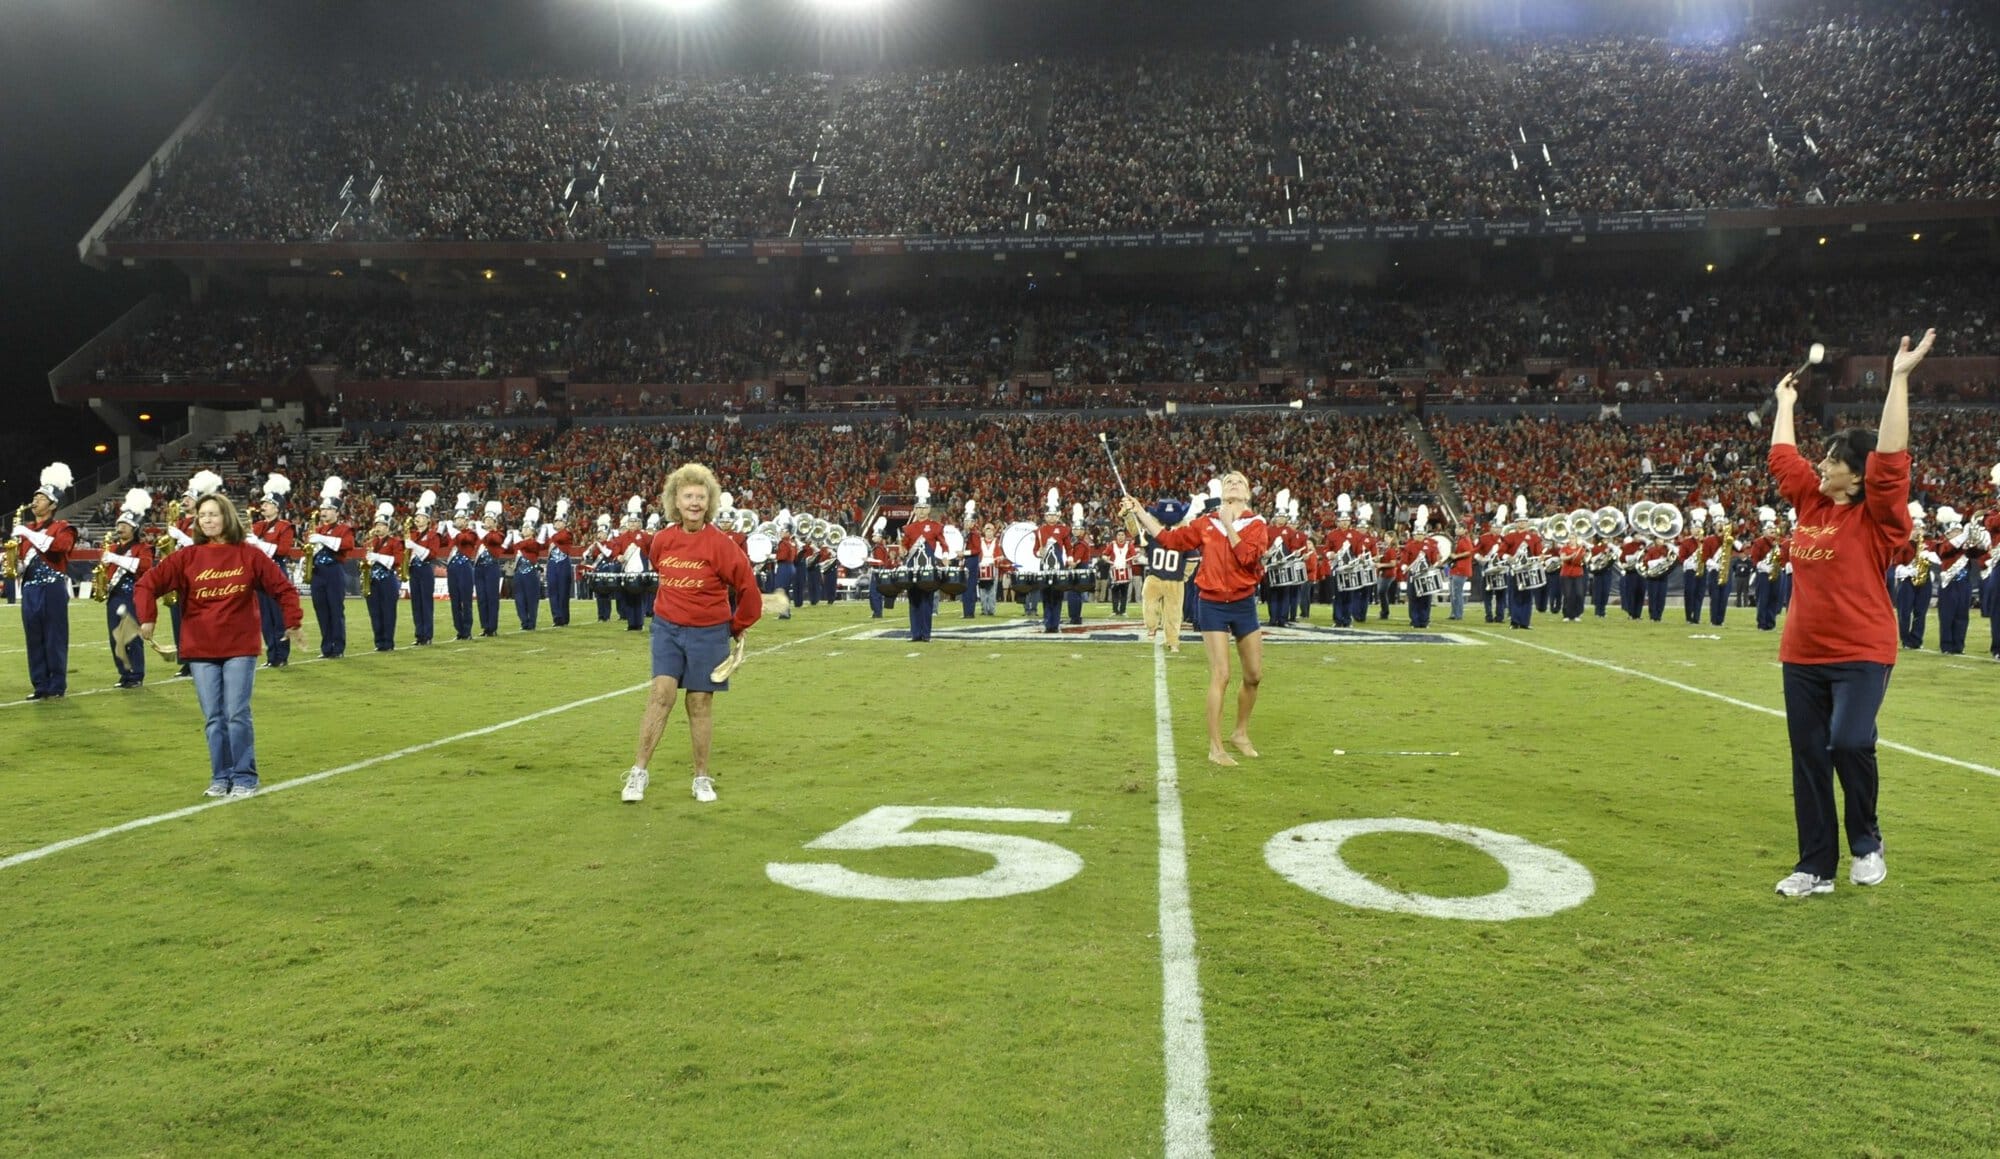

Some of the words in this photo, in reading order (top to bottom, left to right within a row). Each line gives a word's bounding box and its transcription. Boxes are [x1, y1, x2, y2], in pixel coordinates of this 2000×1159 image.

[1866, 371, 1874, 381] 6
[338, 392, 343, 402] 1
[515, 390, 522, 399] 2
[754, 386, 762, 396] 3
[659, 556, 705, 570] Alumni
[1152, 548, 1179, 572] 00
[195, 566, 245, 582] Alumni
[195, 583, 247, 600] Twirler
